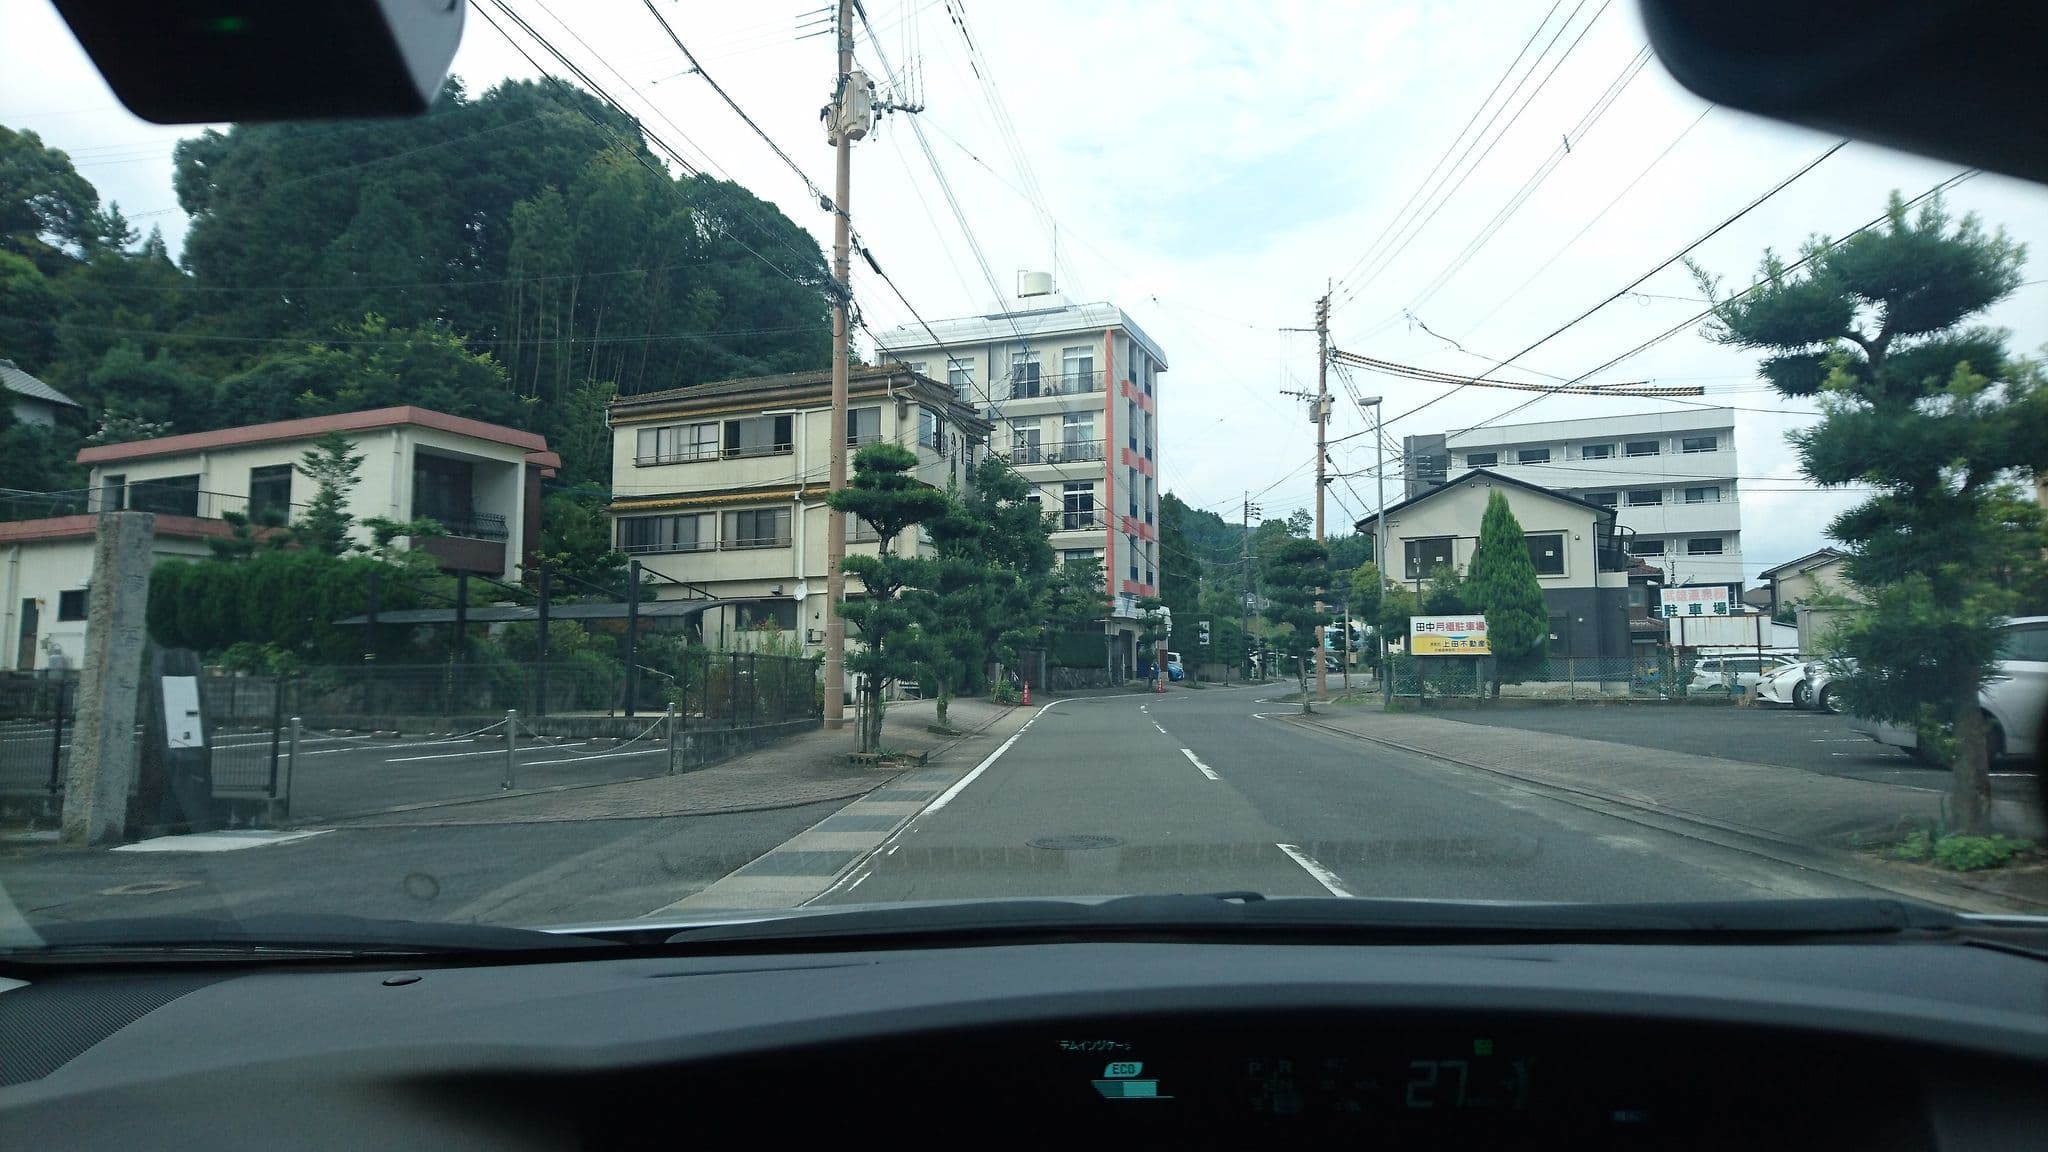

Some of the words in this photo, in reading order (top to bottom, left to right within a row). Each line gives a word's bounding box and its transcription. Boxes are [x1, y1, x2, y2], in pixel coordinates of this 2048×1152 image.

[1664, 602, 1727, 617] 駐車場
[1416, 622, 1485, 632] 田中月極駐車場
[1112, 1064, 1136, 1075] ECO
